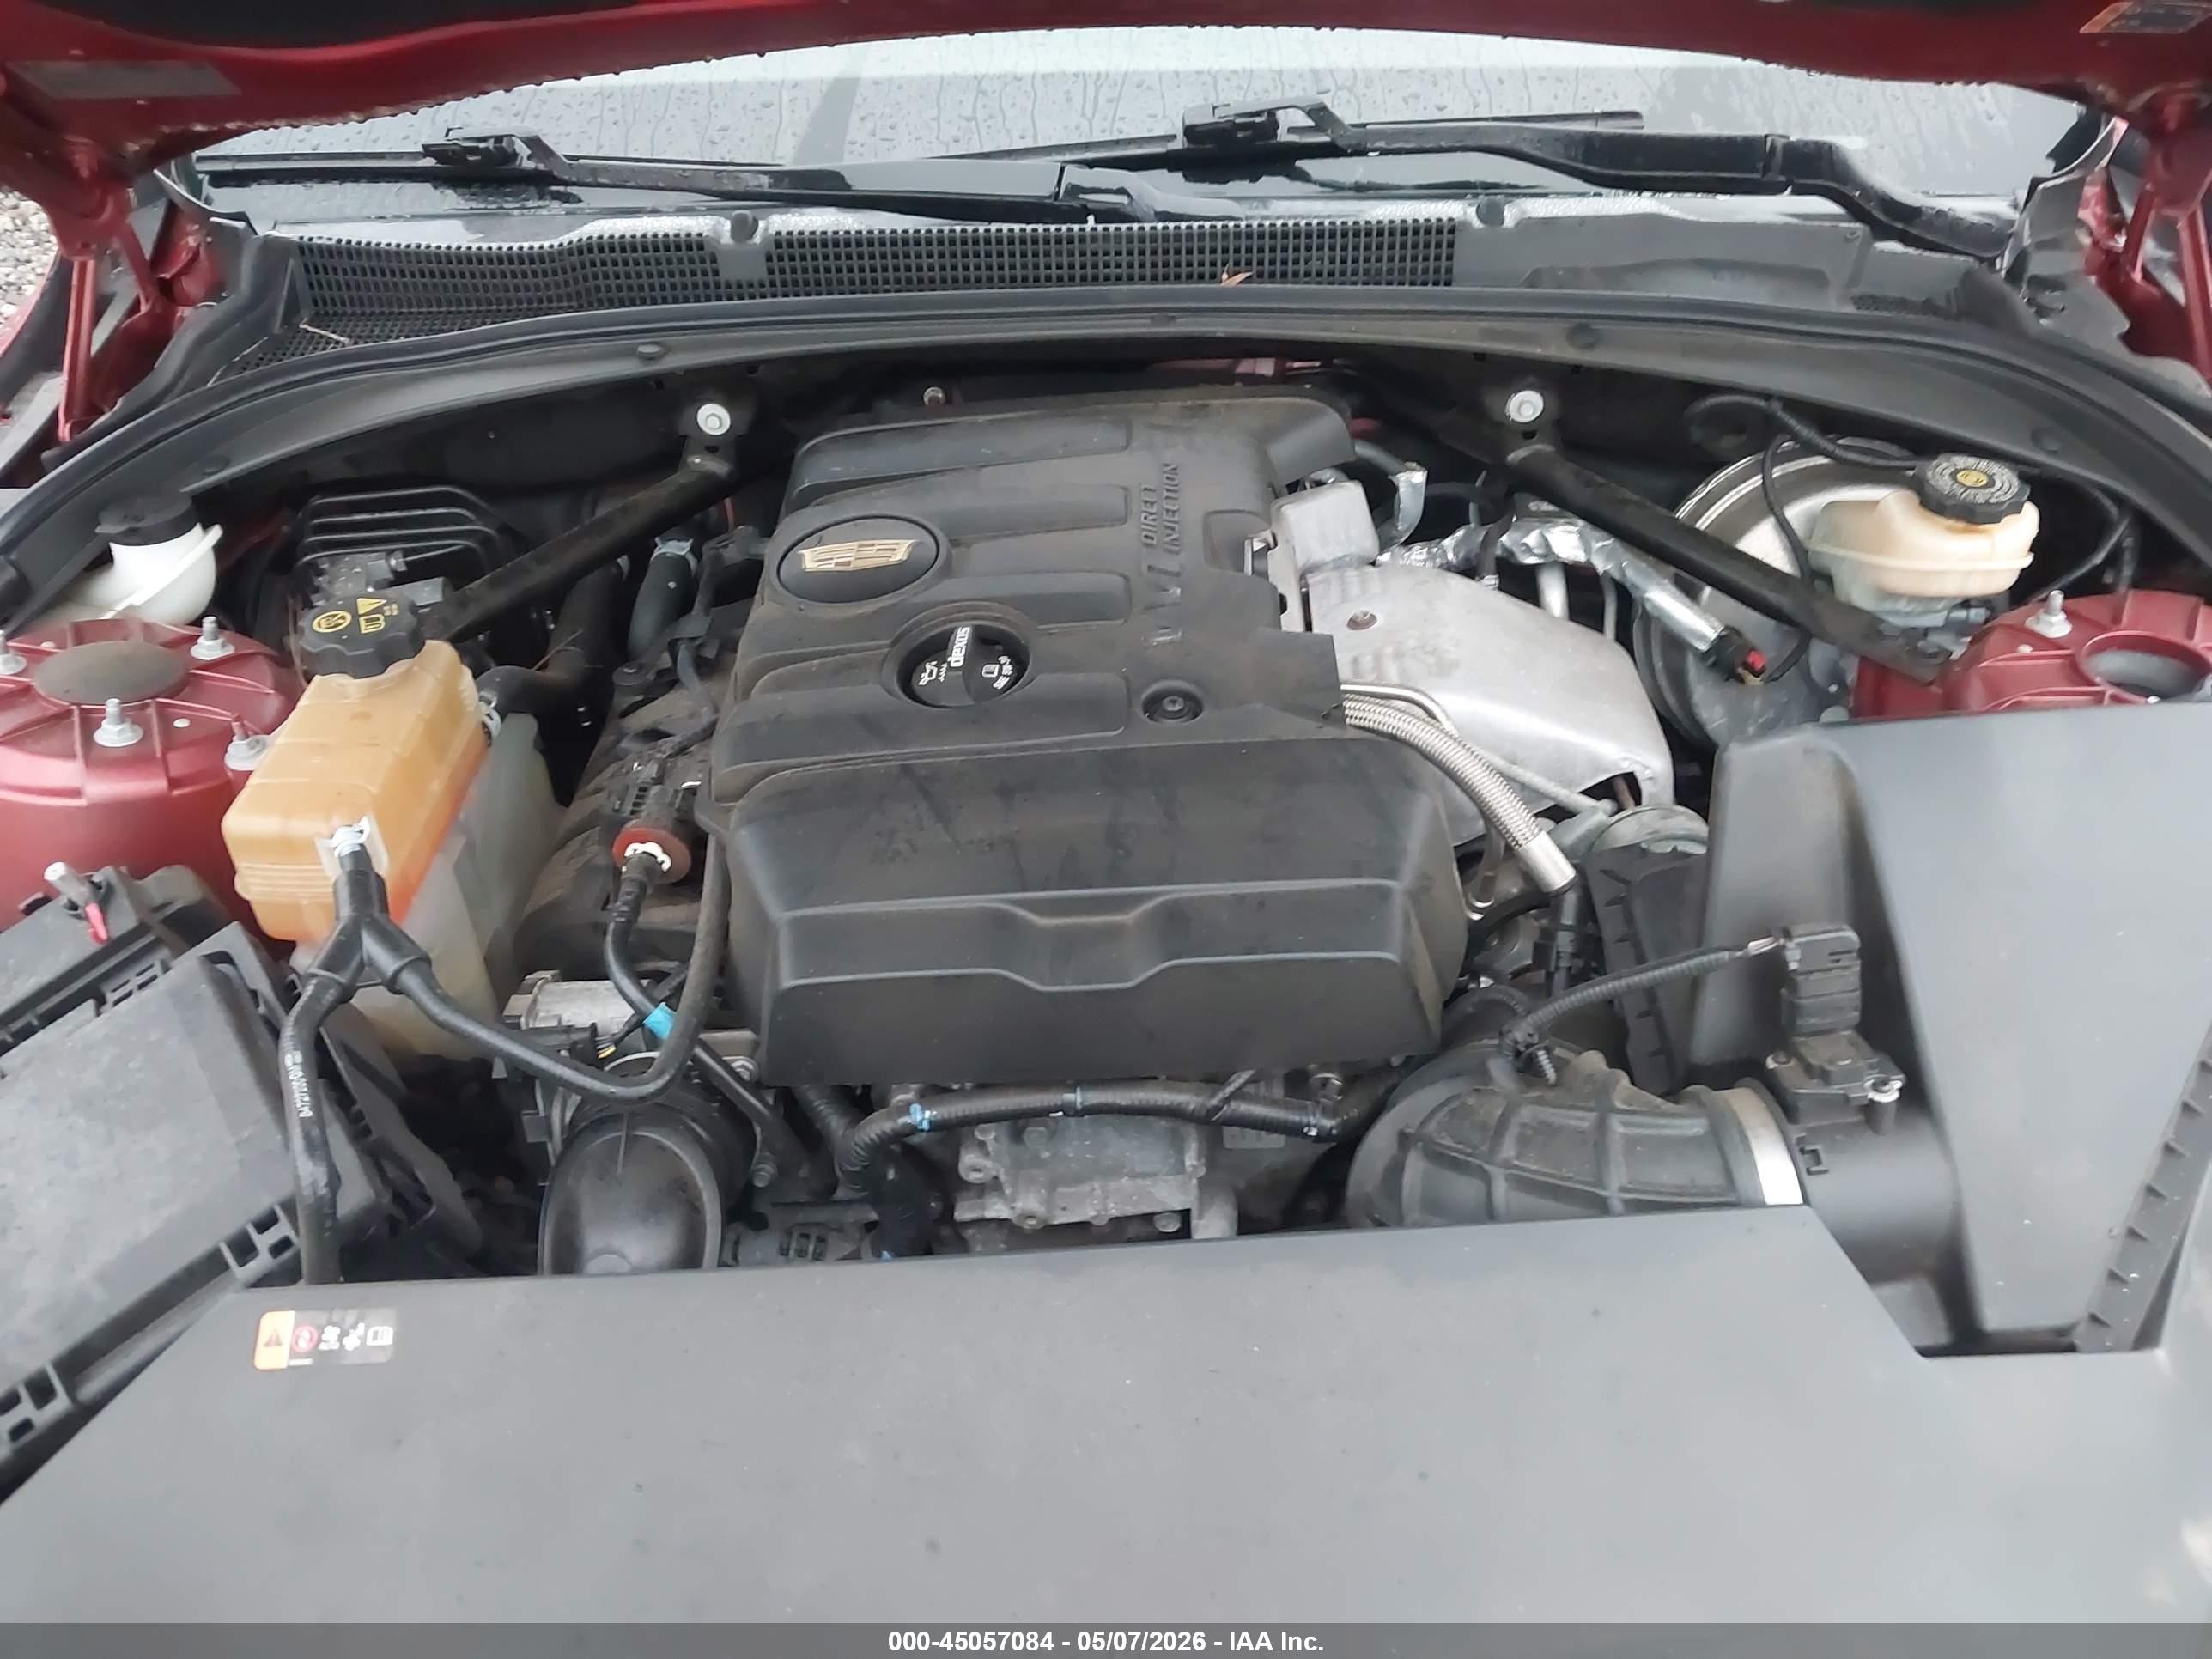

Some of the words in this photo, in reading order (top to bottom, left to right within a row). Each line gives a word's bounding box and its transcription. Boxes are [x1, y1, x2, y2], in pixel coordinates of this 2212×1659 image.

[1140, 482, 1158, 549] DIRECT
[1163, 462, 1182, 556] INJECTION
[947, 626, 971, 668] dexos
